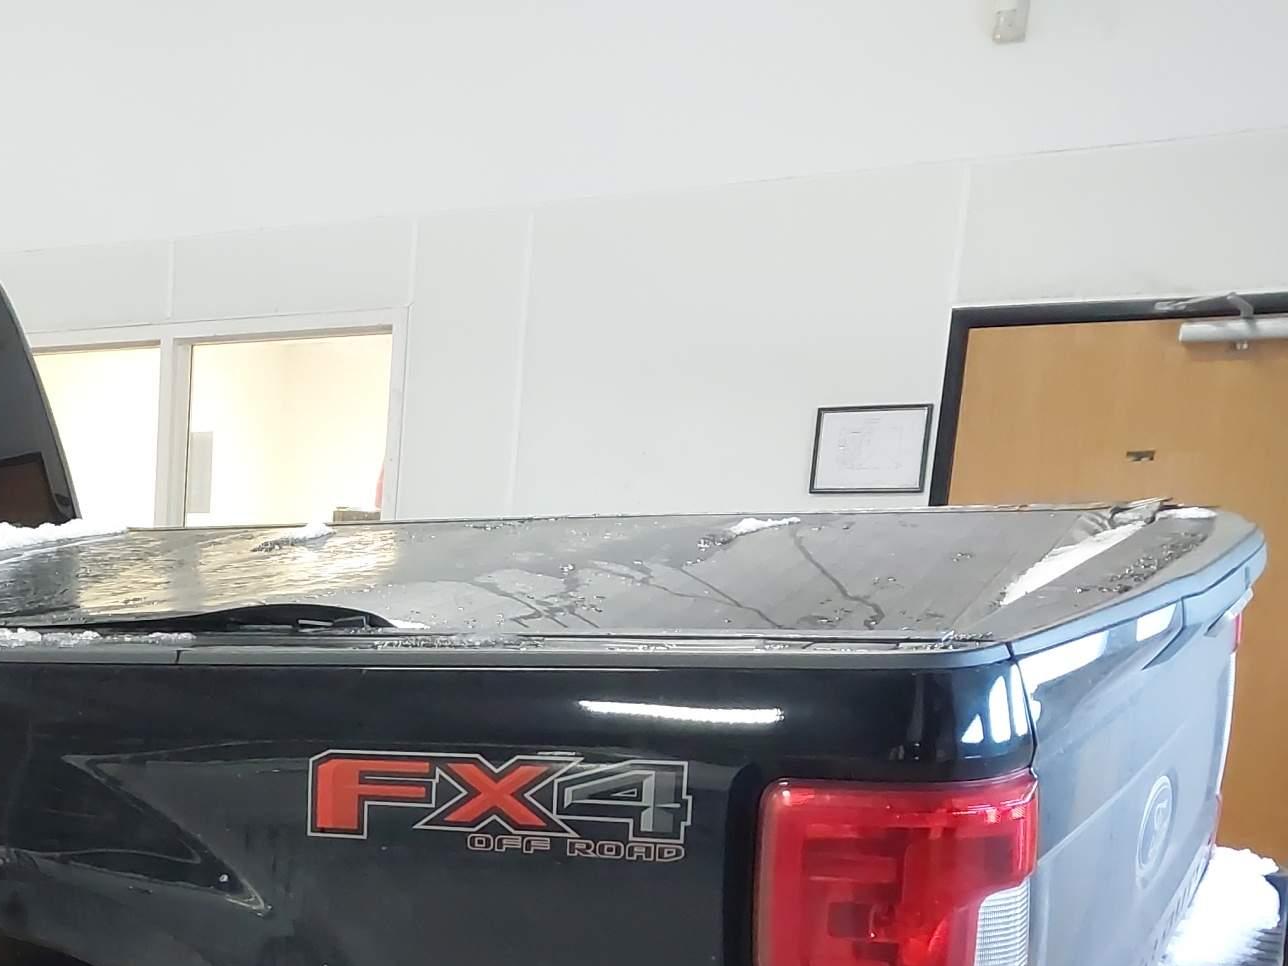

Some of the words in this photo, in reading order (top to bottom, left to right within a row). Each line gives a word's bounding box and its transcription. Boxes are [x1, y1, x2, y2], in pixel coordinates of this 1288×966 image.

[307, 749, 692, 843] FX4
[467, 834, 551, 853] OFF
[566, 839, 685, 862] ROAD
